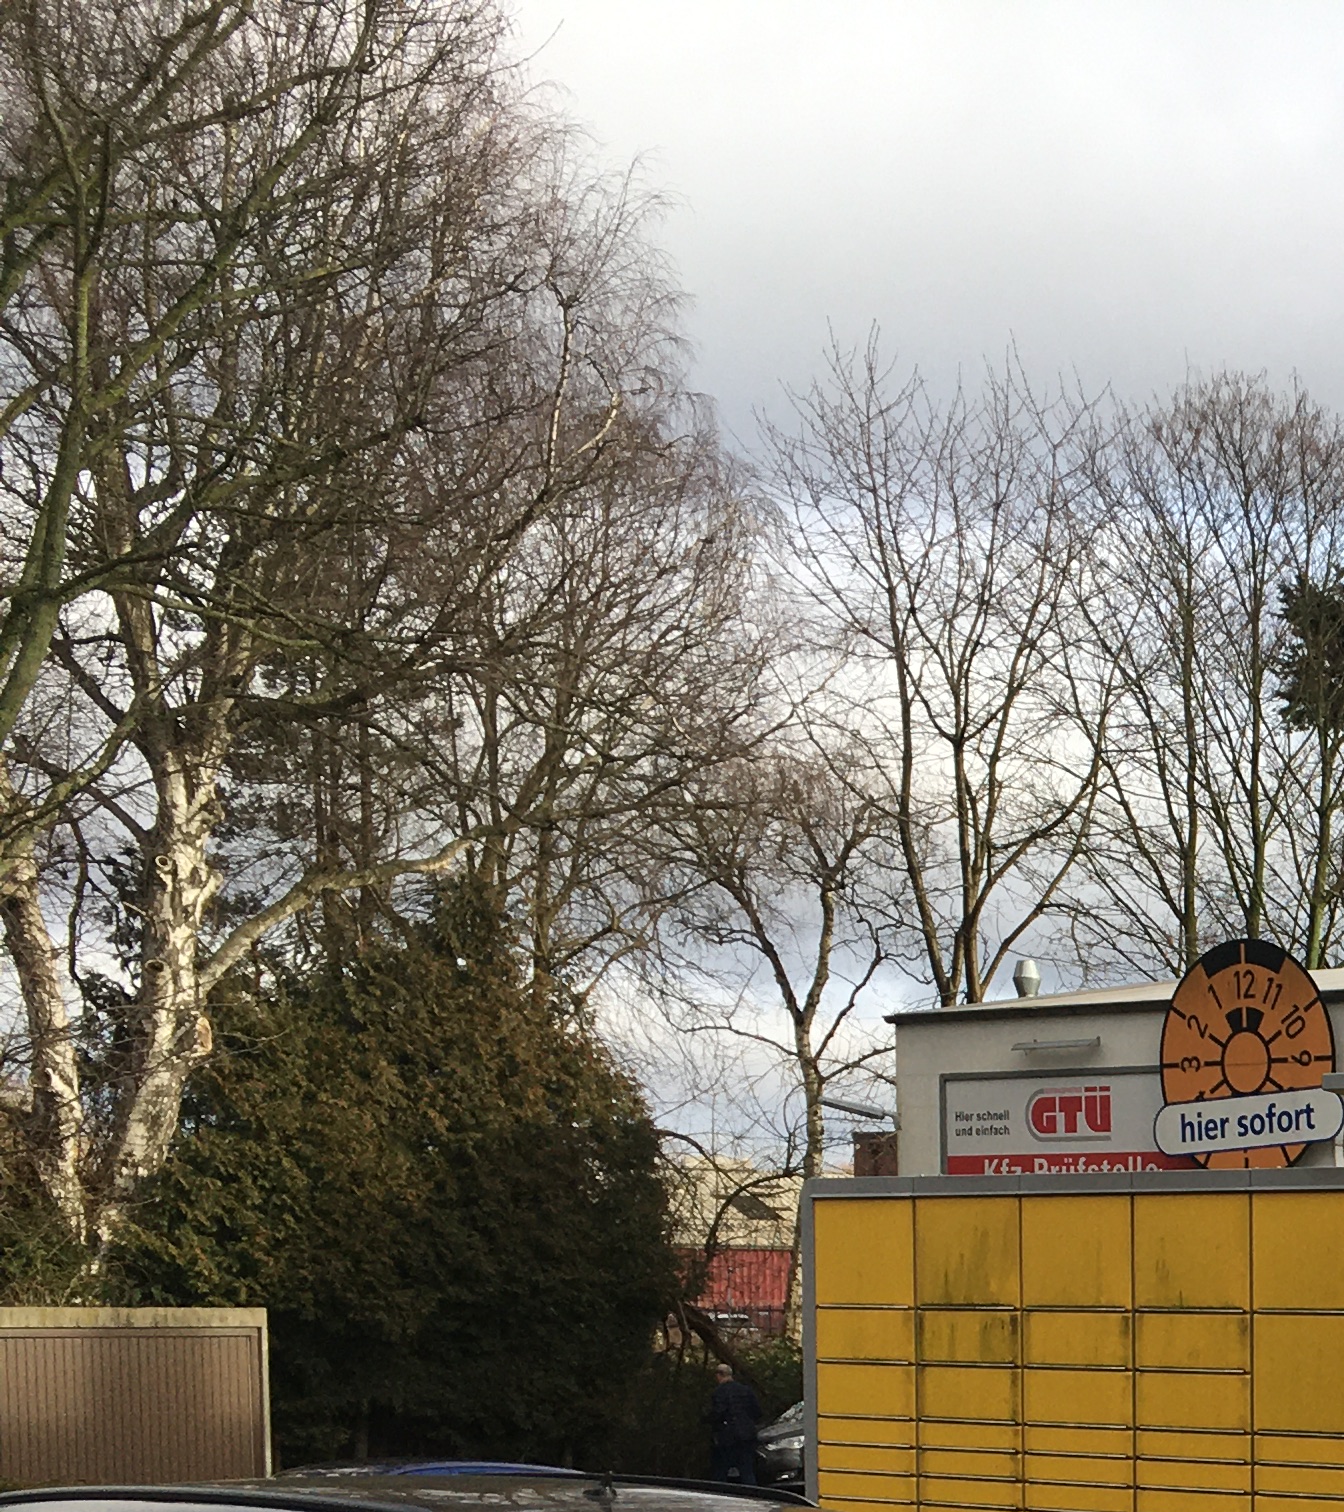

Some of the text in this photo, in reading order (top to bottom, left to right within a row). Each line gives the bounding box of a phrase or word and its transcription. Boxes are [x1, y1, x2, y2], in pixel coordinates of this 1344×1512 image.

[1207, 983, 1223, 1010] 1
[1233, 969, 1257, 1000] 12
[1262, 977, 1283, 1010] 11
[1186, 1014, 1209, 1040] 2
[1280, 1003, 1306, 1040] 10
[1180, 1055, 1202, 1073] 3
[954, 1109, 1010, 1122] Hier schnell
[1031, 1085, 1112, 1134] GTÜ
[1180, 1102, 1316, 1143] hier sofort
[955, 1124, 1011, 1137] und einfach
